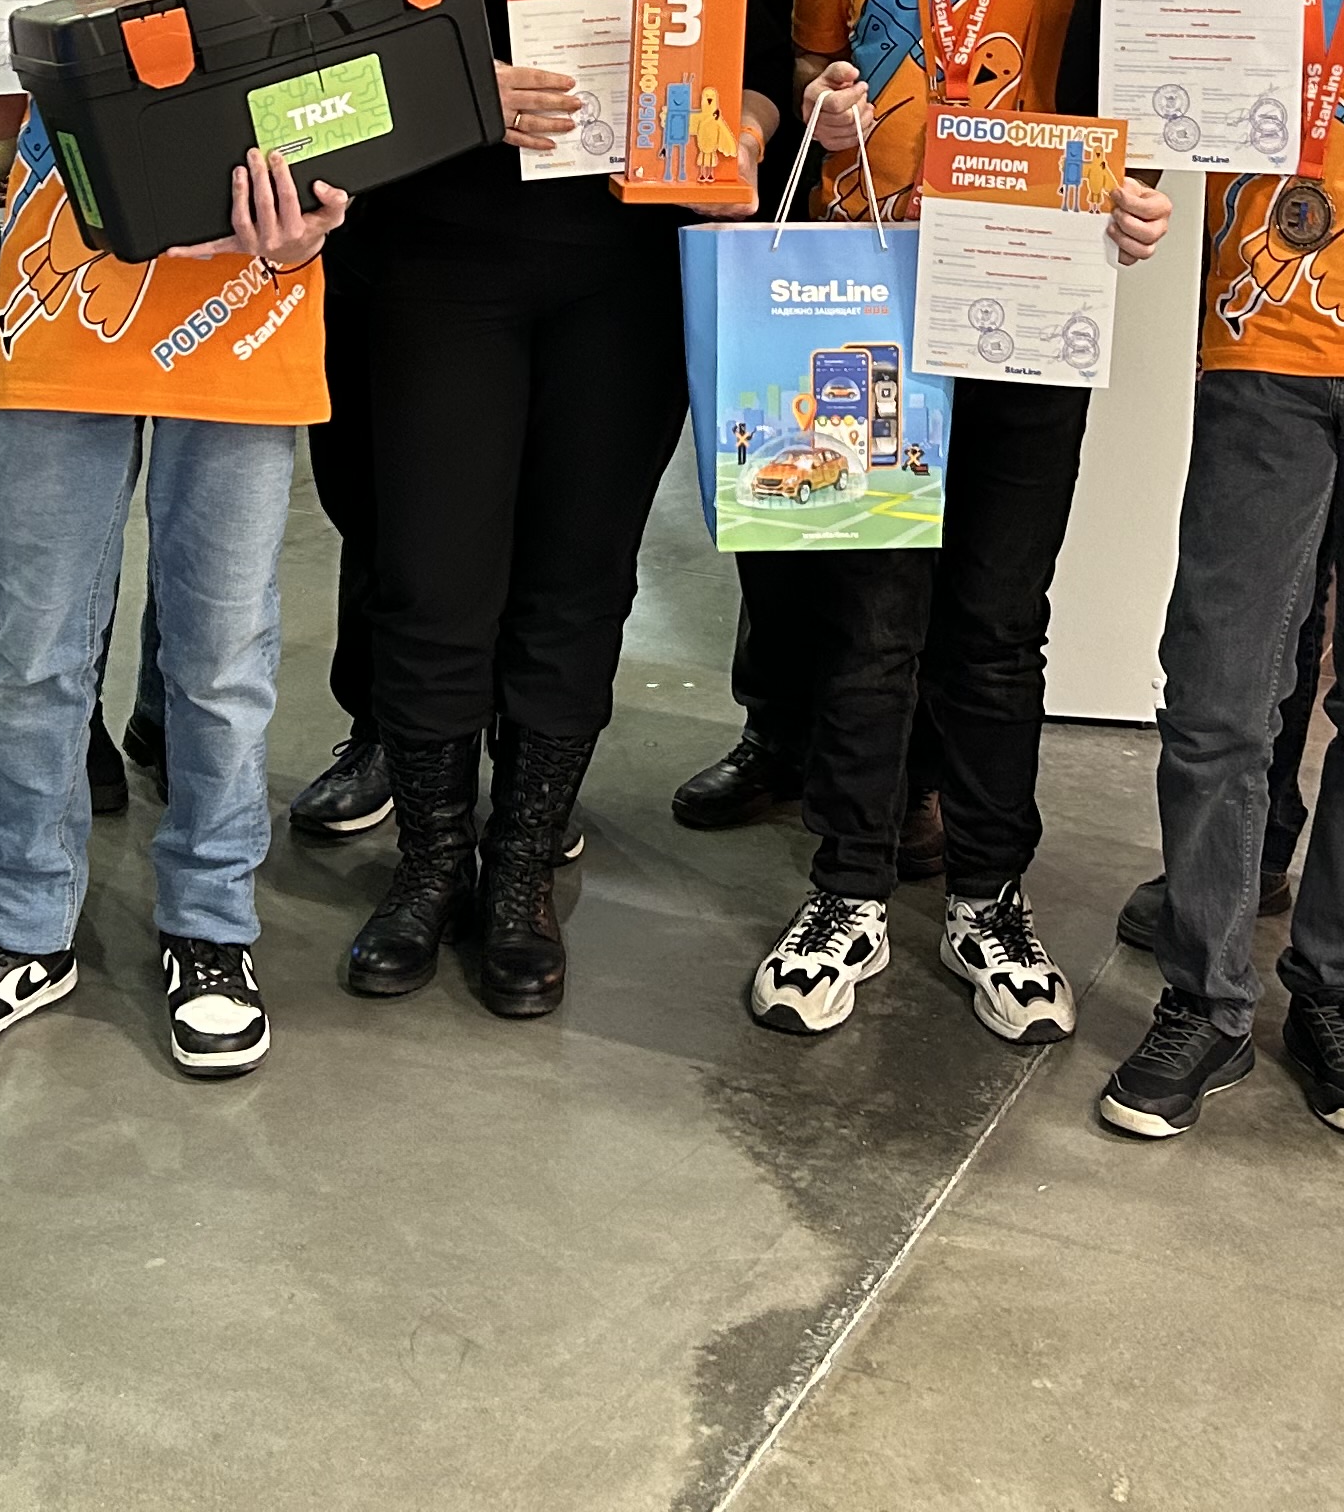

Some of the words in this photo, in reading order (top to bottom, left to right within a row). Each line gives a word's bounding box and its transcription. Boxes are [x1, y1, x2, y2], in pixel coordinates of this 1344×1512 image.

[636, 3, 662, 149] РОБОФИНИСТ
[287, 92, 357, 131] TRIK
[1311, 64, 1344, 140] StarLine
[937, 113, 1118, 152] РОБОФИНИСТ
[952, 155, 1029, 174] ДИПЛОМ
[1191, 154, 1230, 164] StarLine
[951, 172, 1028, 191] ПРИЗЕРА
[770, 279, 890, 302] StarLine
[232, 284, 306, 361] StarLine
[1004, 366, 1042, 376] StarLine
